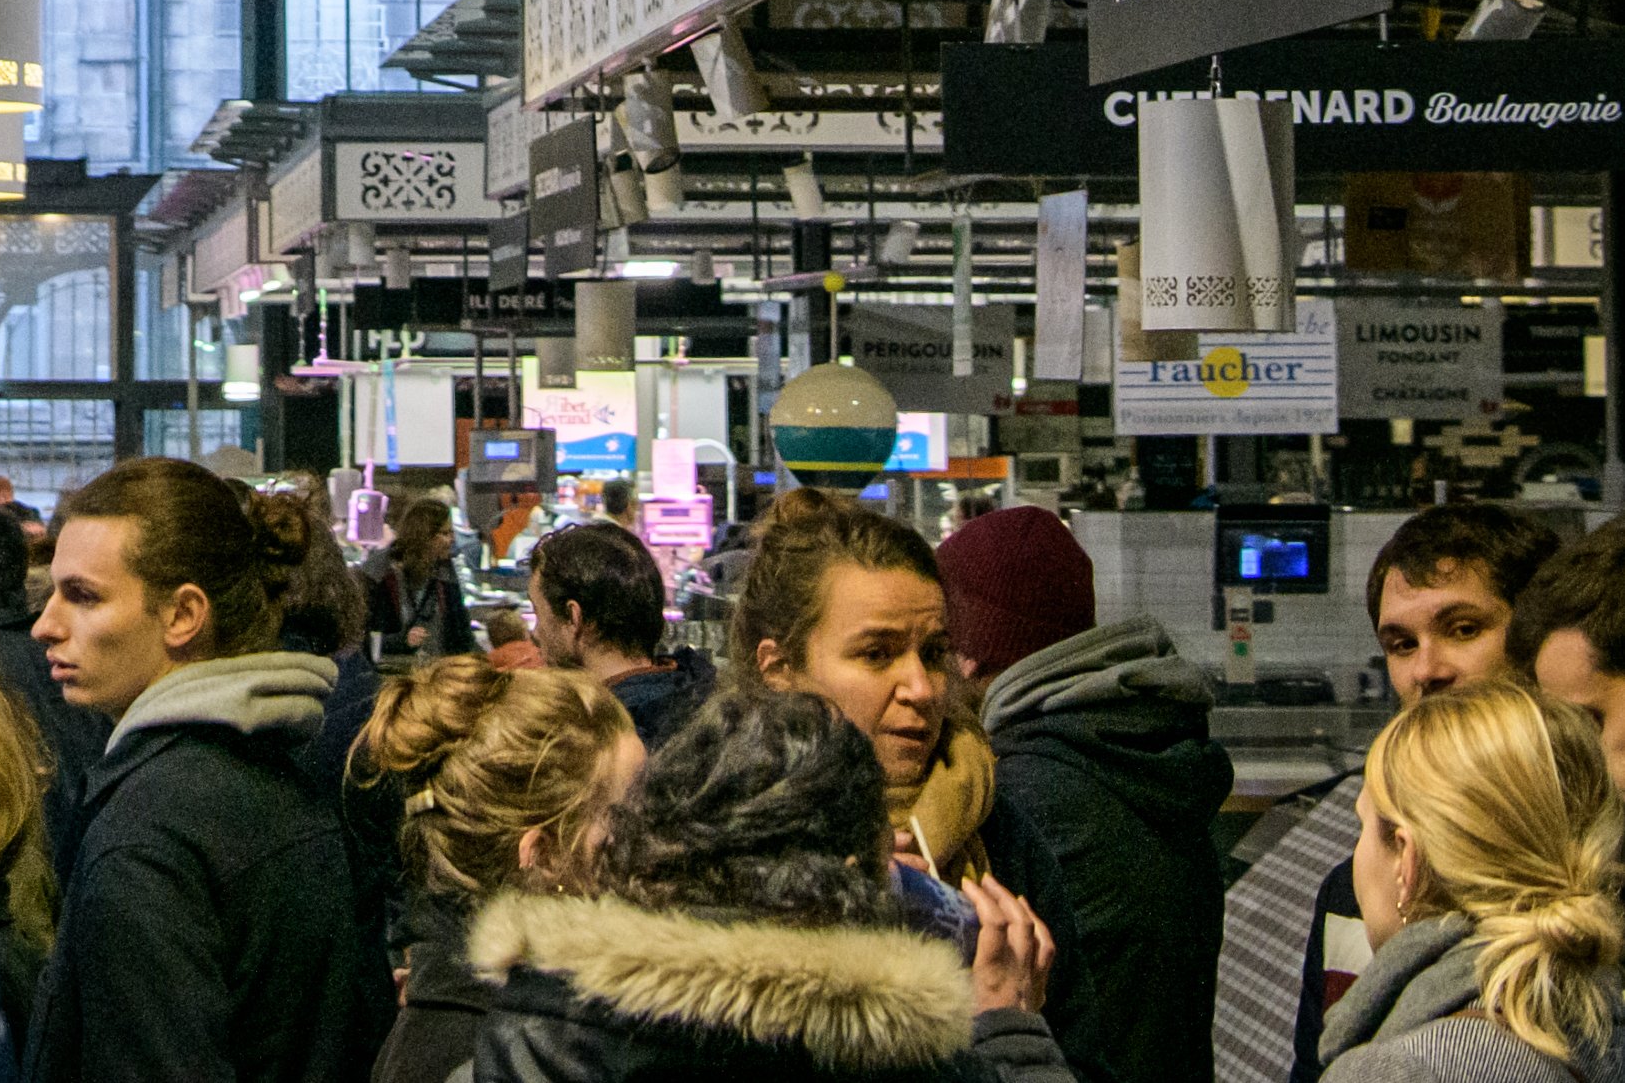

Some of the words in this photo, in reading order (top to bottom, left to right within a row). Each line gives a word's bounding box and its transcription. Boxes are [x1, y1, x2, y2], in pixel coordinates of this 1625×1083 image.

[1425, 91, 1622, 129] Boulangerie
[1356, 323, 1482, 344] LIMOUSIN
[1149, 352, 1304, 382] Faucher
